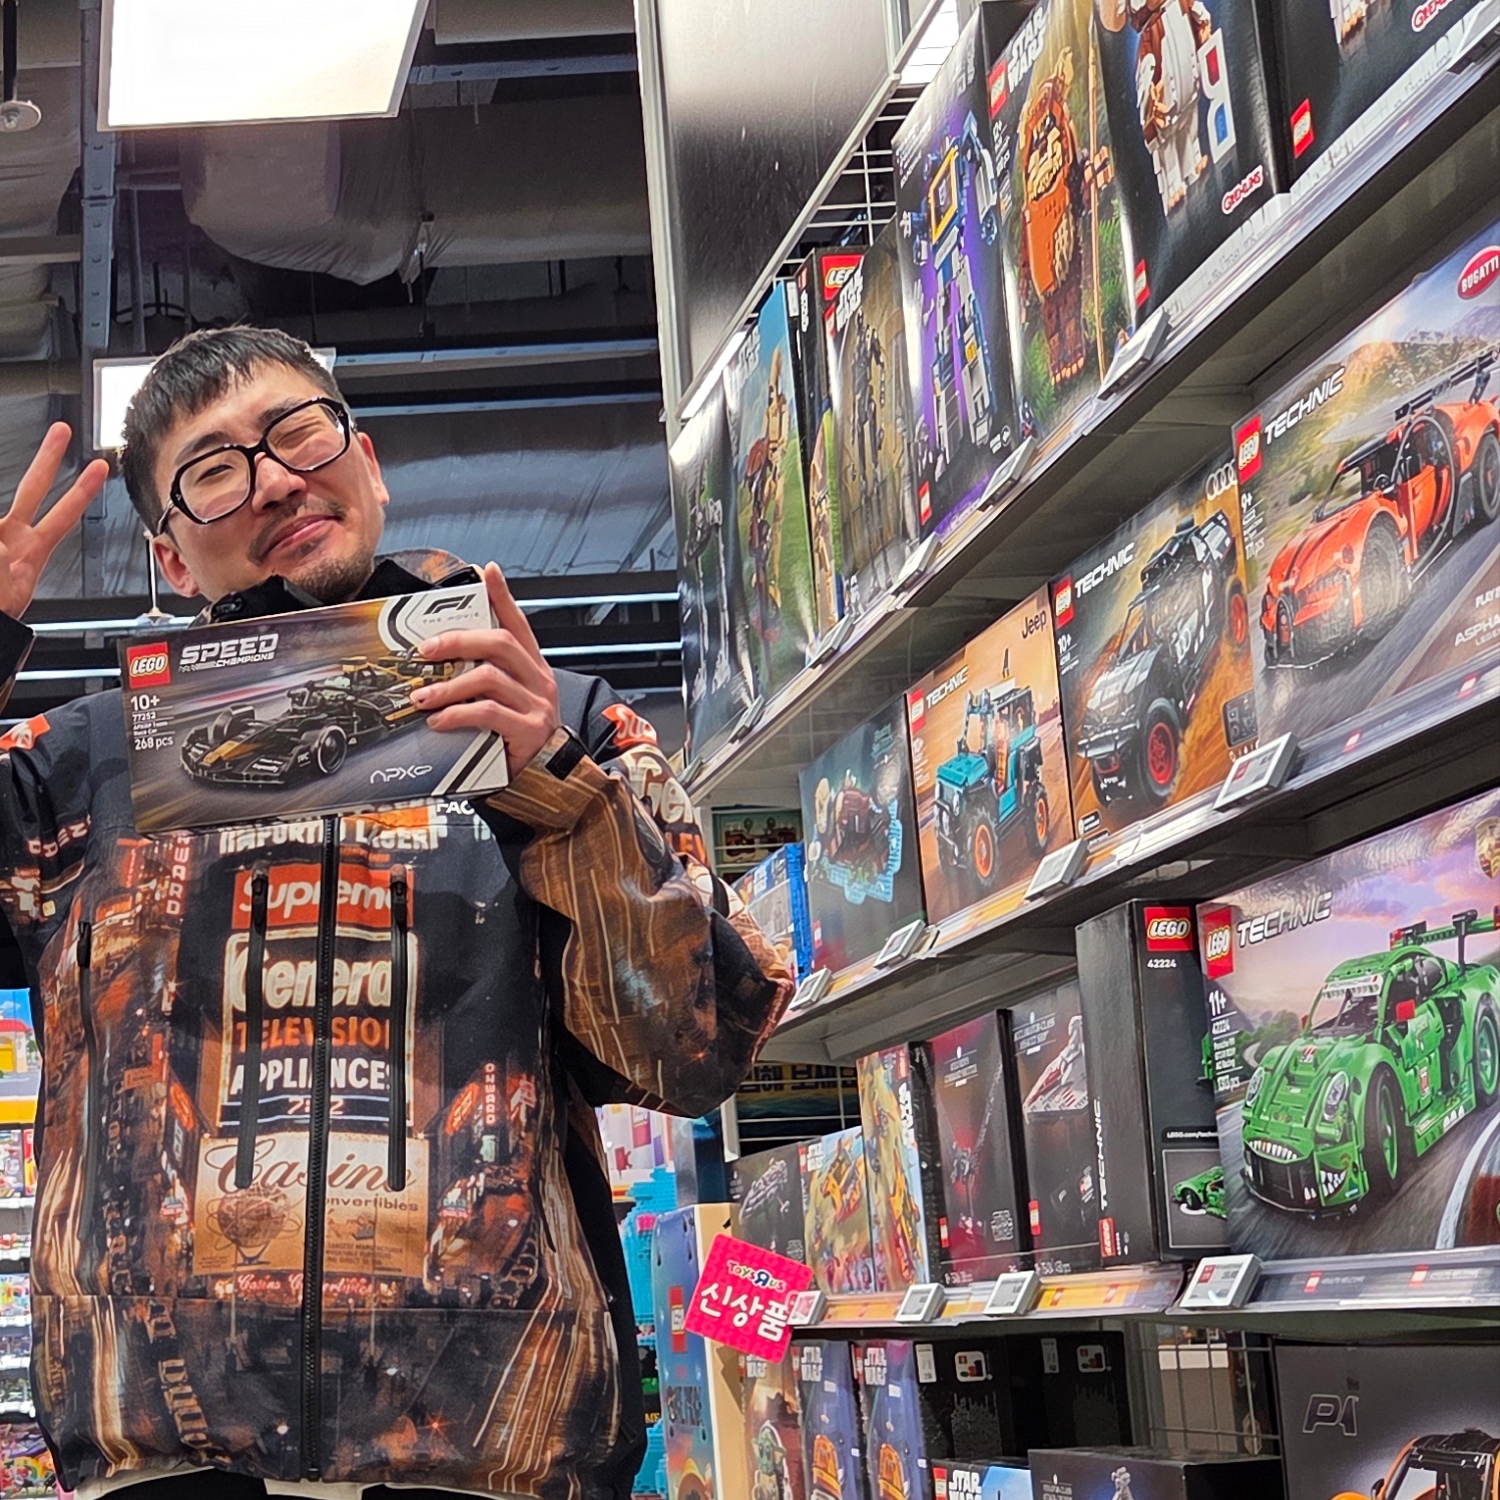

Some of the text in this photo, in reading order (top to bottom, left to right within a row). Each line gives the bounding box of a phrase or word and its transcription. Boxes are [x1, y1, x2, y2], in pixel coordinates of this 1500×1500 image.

[1008, 7, 1049, 68] STAR
[1008, 31, 1046, 93] WARS
[1222, 170, 1262, 212] GREMLINS
[827, 268, 856, 286] LEG
[1461, 254, 1500, 293] BUGATTI
[1264, 366, 1346, 445] TECHNIC
[1238, 432, 1259, 469] LEGO
[1074, 542, 1135, 598] TECHNIC
[446, 612, 480, 622] MOVIE
[1022, 610, 1047, 639] Jeep
[131, 655, 167, 675] LEGO
[180, 633, 279, 665] SPEED
[214, 652, 275, 667] CHAMPIONS
[131, 694, 160, 711] 10+
[926, 664, 969, 709] TECHNIC
[134, 736, 174, 750] 268 pcs
[166, 834, 191, 915] NWARD
[239, 875, 394, 918] Supem
[1149, 919, 1189, 937] LEGO
[1238, 892, 1332, 948] TECHNIC
[1207, 928, 1230, 959] LEGO
[232, 945, 393, 1012] Genera
[1147, 959, 1177, 968] 42224
[1209, 990, 1227, 1016] 11+
[236, 1016, 390, 1053] TLESIO
[230, 1057, 391, 1095] APLINCE
[484, 1062, 496, 1125] ONWARD
[204, 1138, 417, 1194] Cain
[1094, 1099, 1107, 1211] TECHNIC
[326, 1194, 419, 1212] nvertibles
[700, 1282, 789, 1342] 신상품
[949, 1470, 982, 1494] STAR
